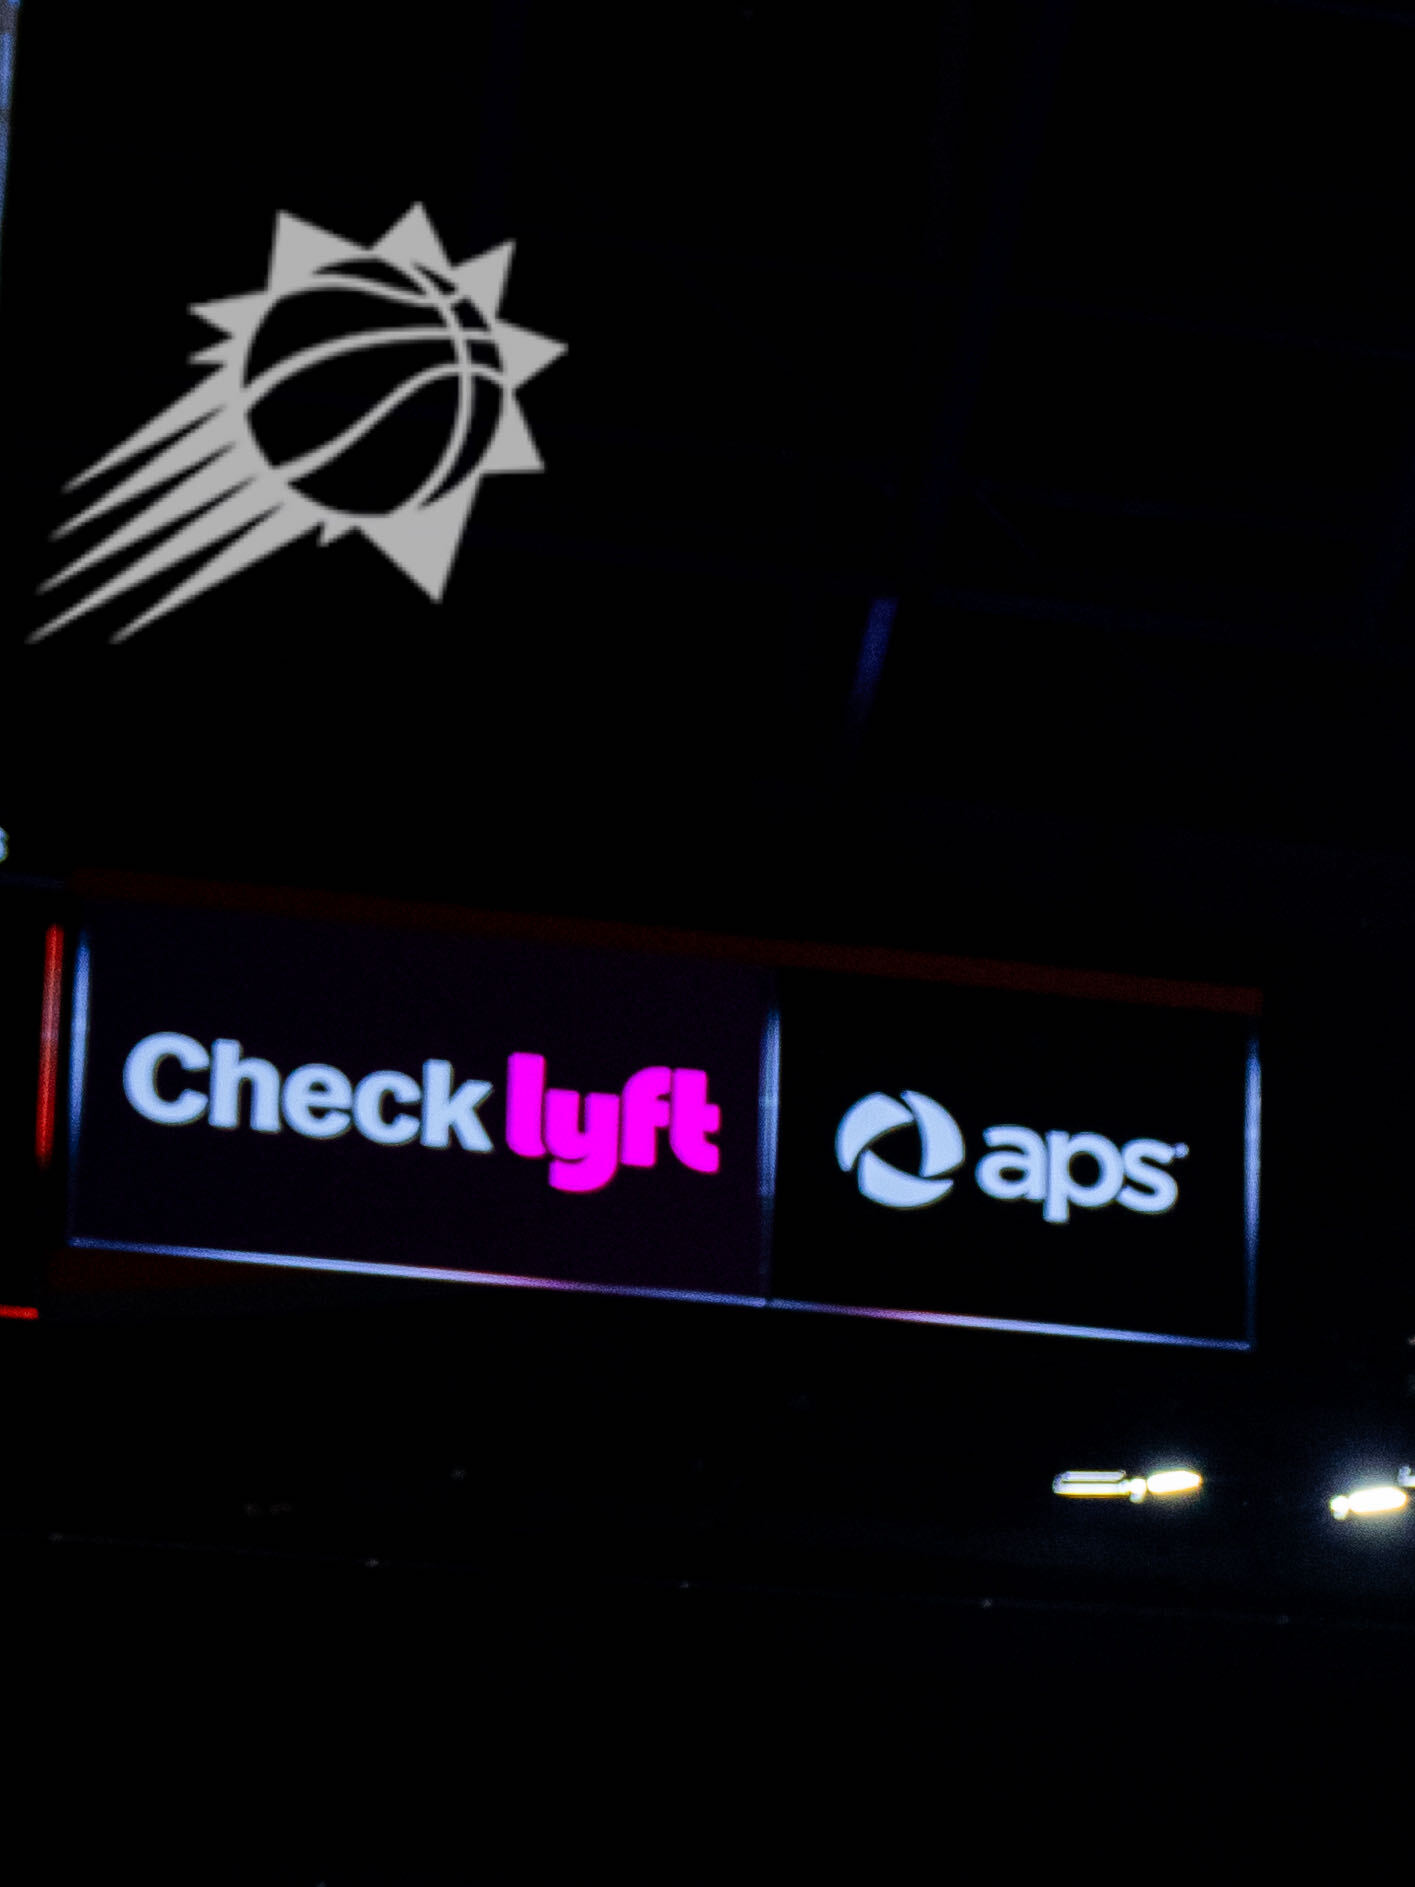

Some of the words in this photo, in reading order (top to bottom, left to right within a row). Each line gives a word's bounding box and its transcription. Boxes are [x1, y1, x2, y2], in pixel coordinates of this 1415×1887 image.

[123, 1031, 495, 1153] Check
[505, 1052, 721, 1192] lyft
[975, 1124, 1179, 1224] aps
